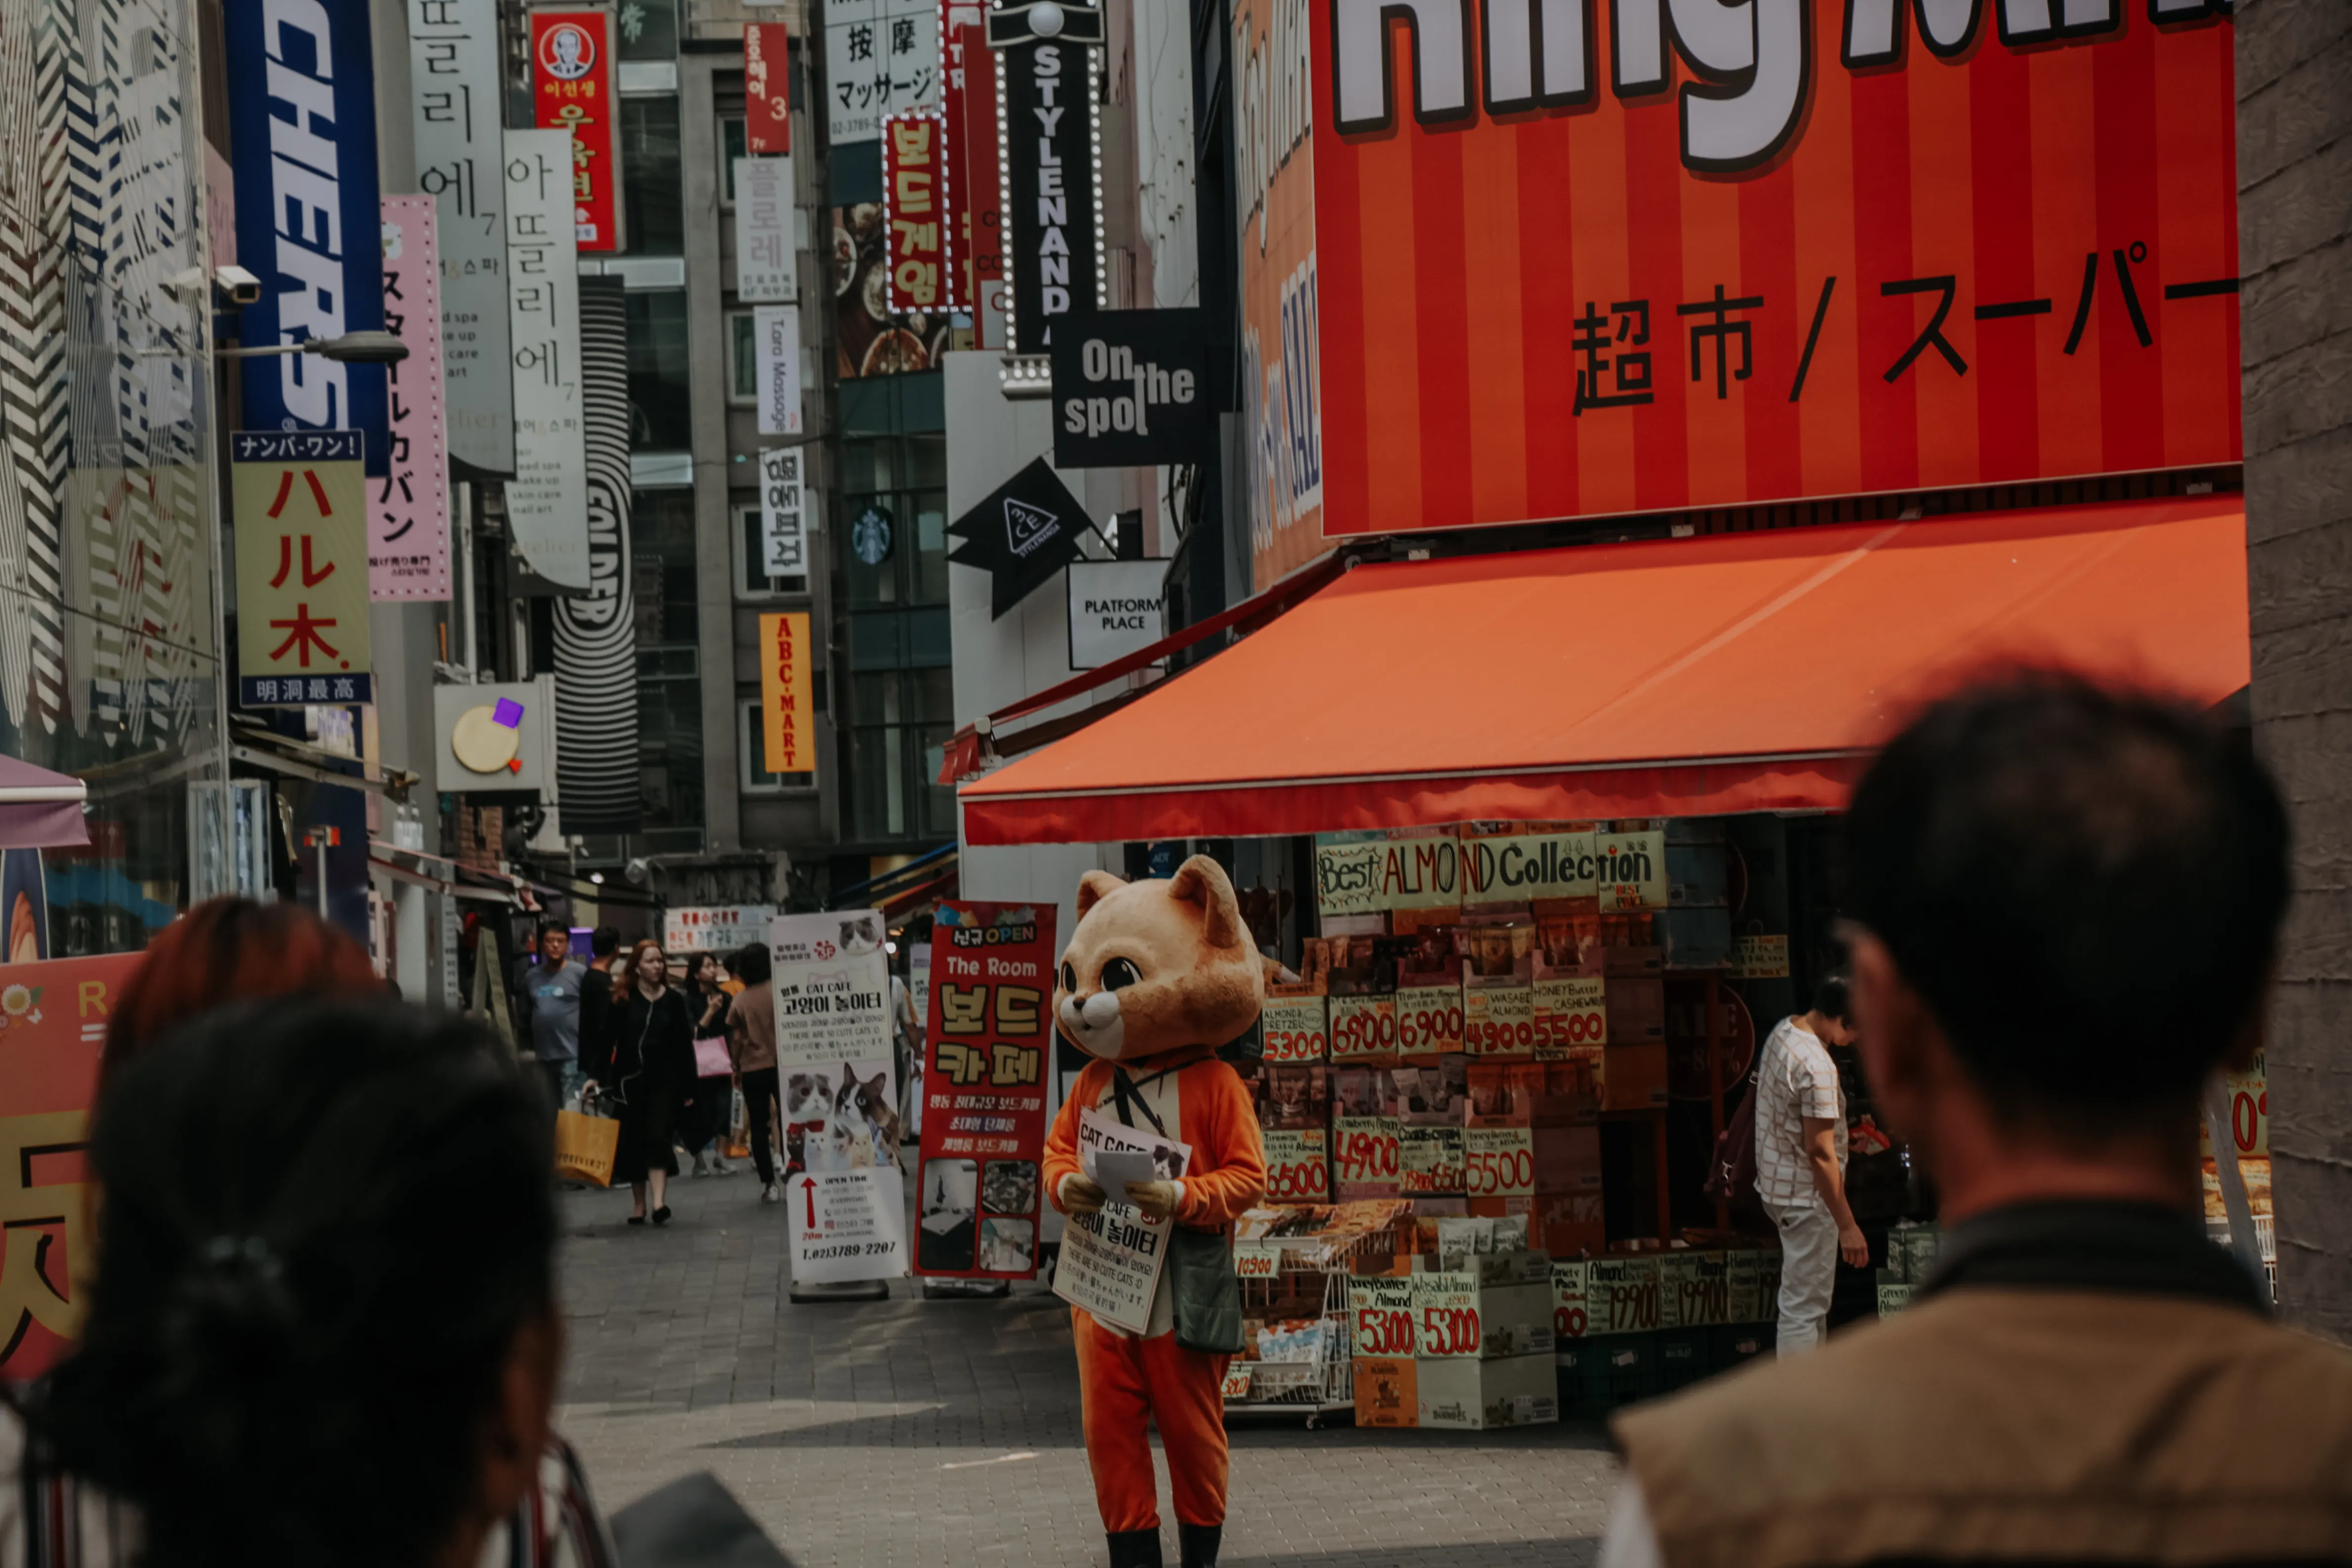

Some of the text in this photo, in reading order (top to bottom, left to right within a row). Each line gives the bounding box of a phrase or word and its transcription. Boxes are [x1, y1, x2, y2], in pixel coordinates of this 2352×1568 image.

[848, 17, 916, 63] 按摩
[545, 81, 595, 98] 이선생
[836, 65, 932, 109] マッサージ
[770, 96, 787, 120] 3
[892, 122, 938, 305] 보드게임
[507, 154, 559, 387] 아뜰리에
[454, 313, 479, 324] spa
[448, 349, 479, 359] care
[1082, 339, 1133, 381] On
[767, 455, 801, 567] 명동피자
[1085, 598, 1162, 614] PLATFORM
[1102, 616, 1145, 630] PLACE
[256, 678, 355, 702] 明洞最高
[1321, 841, 1652, 895] Best ALMOND Collection
[953, 926, 1034, 946] 신규 OPEN
[947, 956, 980, 976] The
[987, 957, 1037, 977] Room
[806, 981, 852, 994] CAT CAFE
[1490, 992, 1530, 1004] WASABI
[783, 991, 882, 1015] 고양이 놀이터
[941, 983, 1041, 1034] 보드
[1492, 1006, 1530, 1016] ALMOND
[1553, 996, 1606, 1010] CASHEWNUT
[788, 1031, 810, 1040] THERE
[812, 1030, 825, 1039] ARE
[836, 1029, 853, 1037] CUTE
[855, 1027, 872, 1036] CATS
[1264, 1019, 1304, 1030] PRETZEL
[1332, 1012, 1396, 1053] 6900
[1399, 1007, 1463, 1048] 6900
[1534, 1012, 1603, 1047] 5500
[1263, 1031, 1326, 1060] 5300
[1466, 1021, 1533, 1053] 4900
[937, 1043, 1040, 1085] 카페
[1375, 1117, 1398, 1130] Almon
[1080, 1123, 1148, 1152] CAT CA
[1296, 1142, 1323, 1153] Almond
[1334, 1129, 1399, 1180] 4900
[825, 1176, 847, 1185] OPEN
[1266, 1161, 1327, 1197] 6500
[1466, 1148, 1534, 1194] 5500
[1106, 1200, 1132, 1219] CAFE
[1108, 1218, 1159, 1257] 놀이터
[1068, 1246, 1082, 1263] THERE
[1081, 1253, 1092, 1268] ARE
[1100, 1261, 1117, 1279] CUTE
[1117, 1267, 1134, 1284] CATS
[1237, 1257, 1272, 1276] 10900
[1590, 1260, 1627, 1281] Almond
[1350, 1277, 1374, 1293] oney
[1412, 1274, 1476, 1295] Wasabi Almond
[1879, 1286, 1908, 1300] Green
[1375, 1291, 1412, 1308] Almond
[1609, 1283, 1659, 1330] 19900
[1879, 1300, 1907, 1314] Almo
[1359, 1308, 1415, 1355] 5300
[1424, 1307, 1480, 1355] 5300
